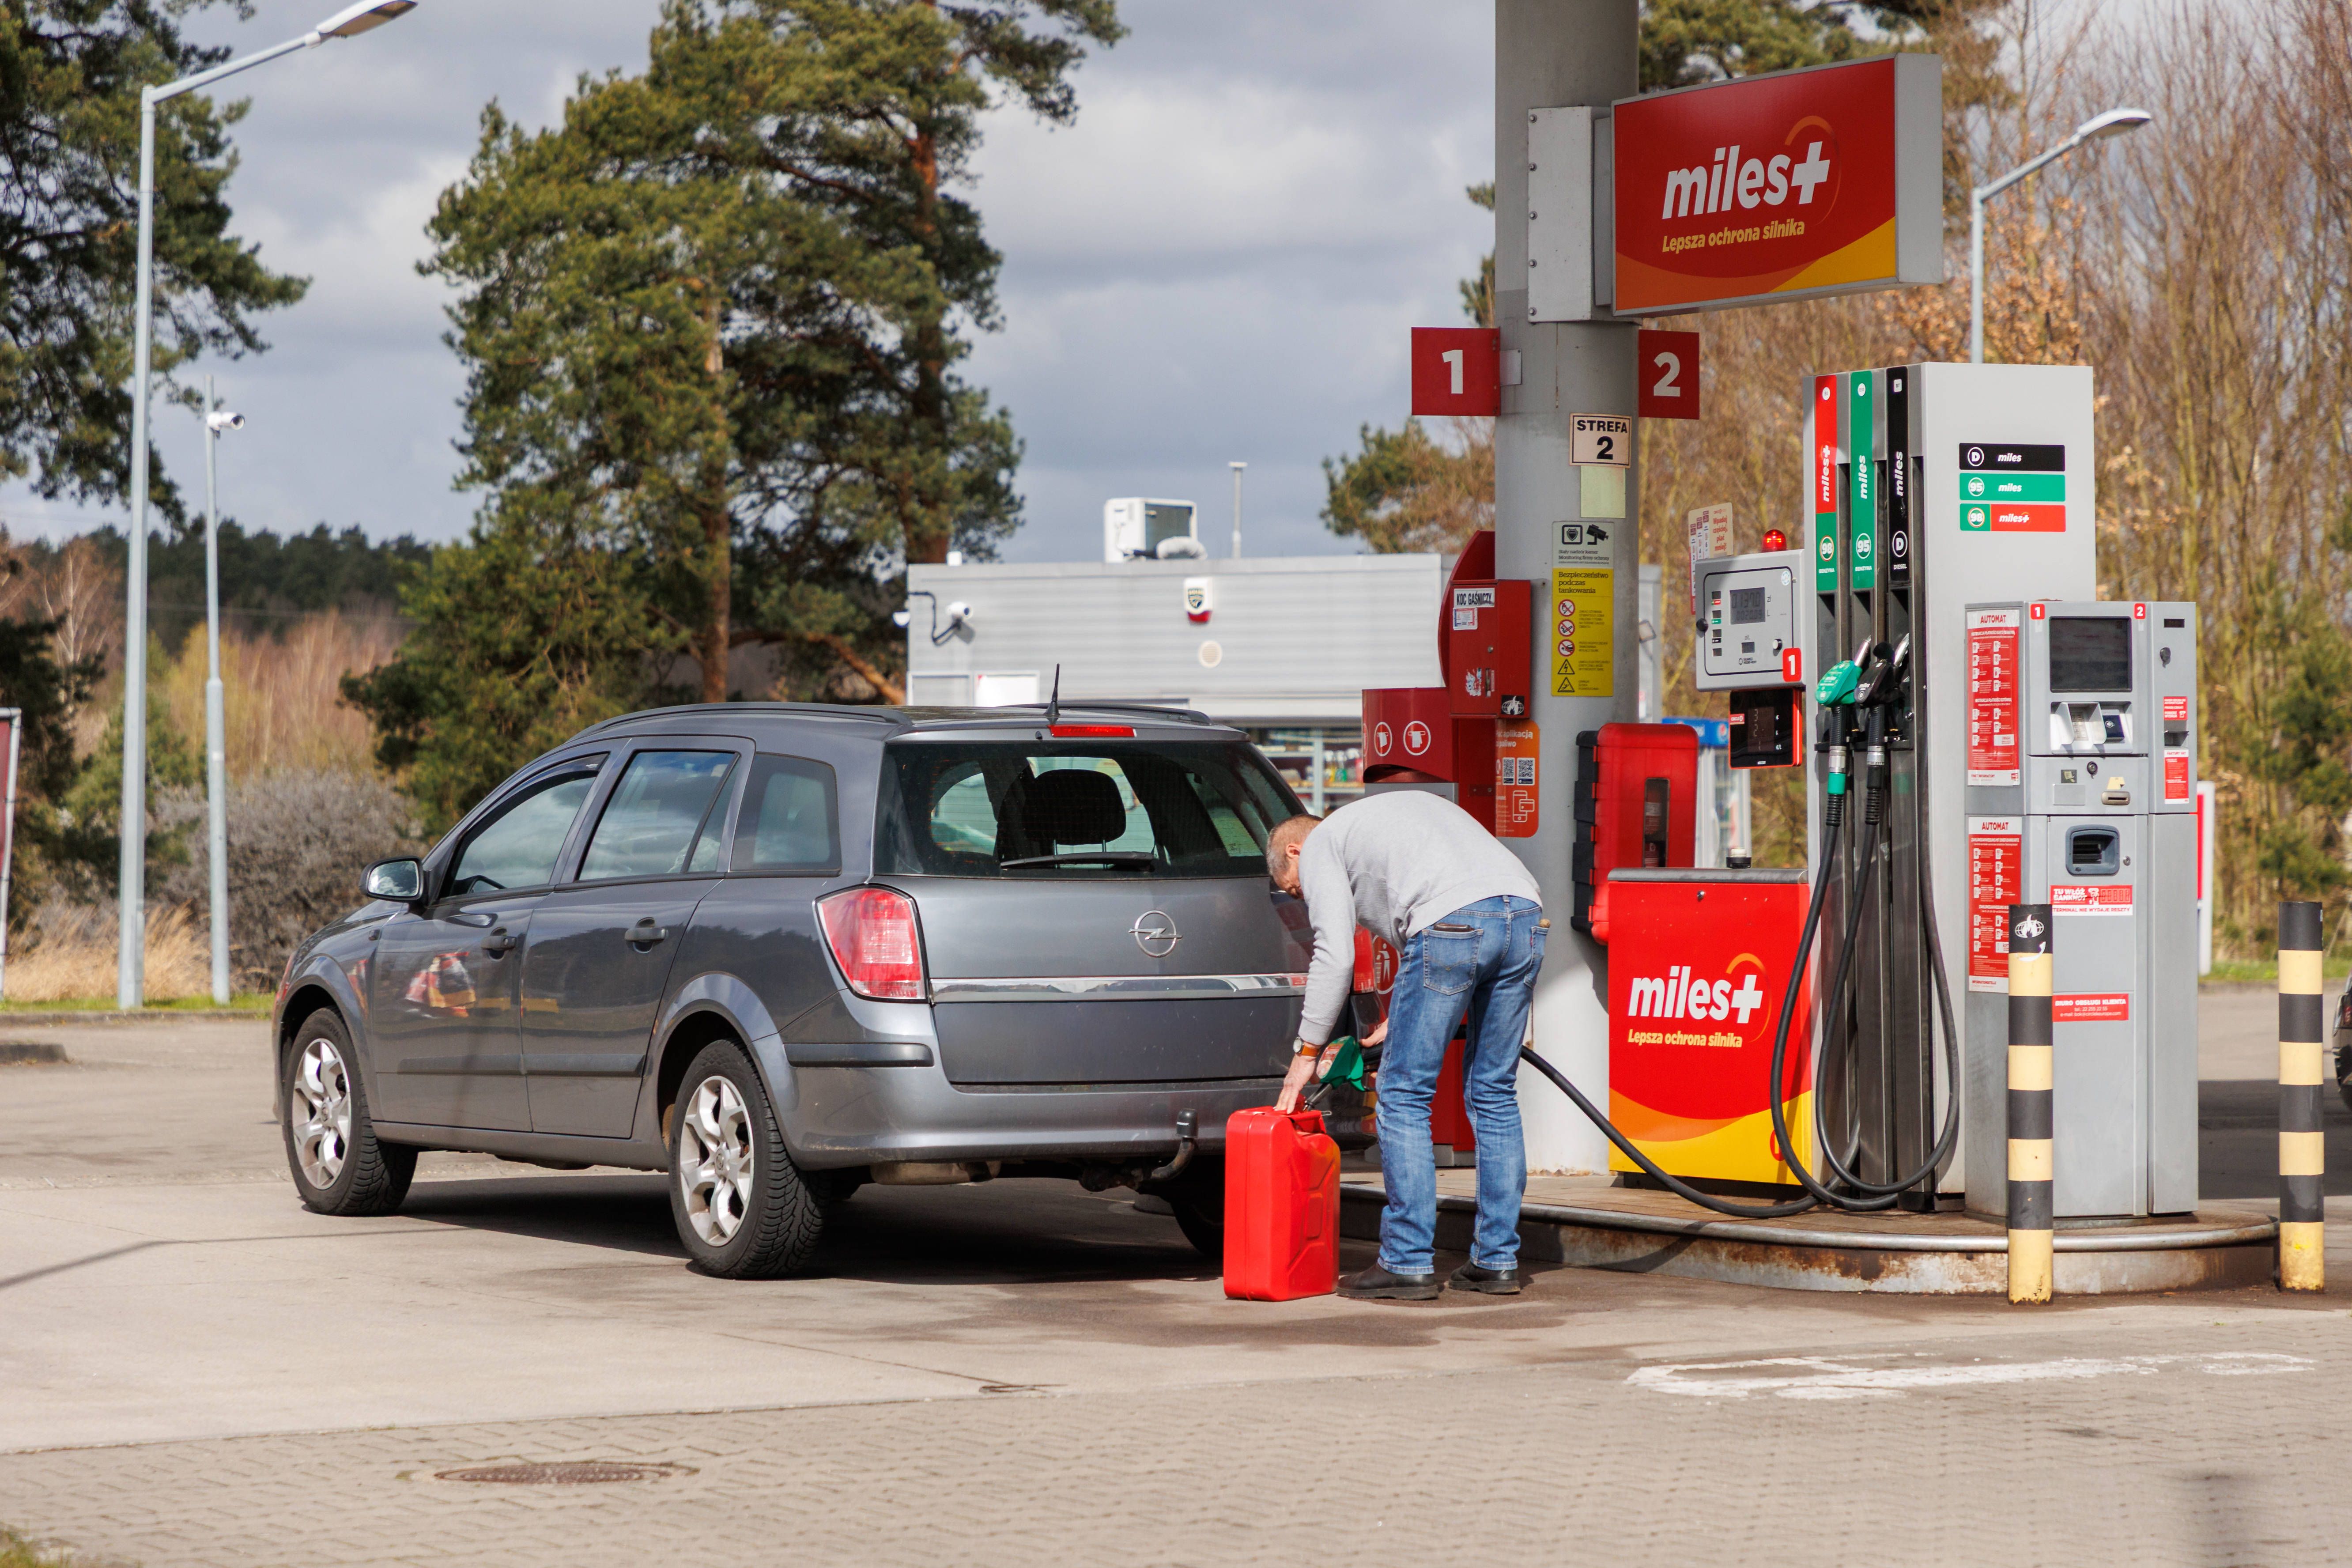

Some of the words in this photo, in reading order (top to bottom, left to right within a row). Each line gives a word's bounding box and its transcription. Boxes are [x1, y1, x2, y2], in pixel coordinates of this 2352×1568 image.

[1662, 141, 1830, 219] miles+
[1662, 233, 1706, 254] Lepsza
[1708, 227, 1760, 246] ochrona
[1763, 218, 1805, 240] silnika
[1442, 349, 1463, 394] 1
[1653, 351, 1680, 397] 2
[1576, 419, 1627, 434] STREFA
[1596, 436, 1614, 460] 2
[1971, 452, 1980, 462] D
[1998, 453, 2022, 462] miles
[1821, 445, 1831, 502] miles+
[1858, 455, 1868, 499] miles
[1894, 451, 1903, 496] miles
[1970, 482, 1983, 492] 95
[1998, 483, 2022, 492] miles
[1970, 513, 1983, 522] 98
[1999, 513, 2030, 523] miles+
[1822, 543, 1833, 555] 98
[1857, 540, 1870, 553] 95
[1896, 537, 1904, 550] D
[1457, 593, 1466, 605] KOC
[1468, 591, 1491, 605] GAŚNICZY
[2035, 607, 2040, 617] 1
[2137, 606, 2143, 616] 2
[1980, 615, 2006, 623] AUTOMAT
[1788, 655, 1795, 675] 1
[1503, 729, 1533, 739] aplikacją
[1982, 822, 2008, 831] AUTOMAT
[1628, 966, 1763, 1024] miles+
[1627, 1029, 1663, 1046] Lepsza
[1664, 1030, 1706, 1046] ochrona
[1708, 1032, 1743, 1048] silnika
